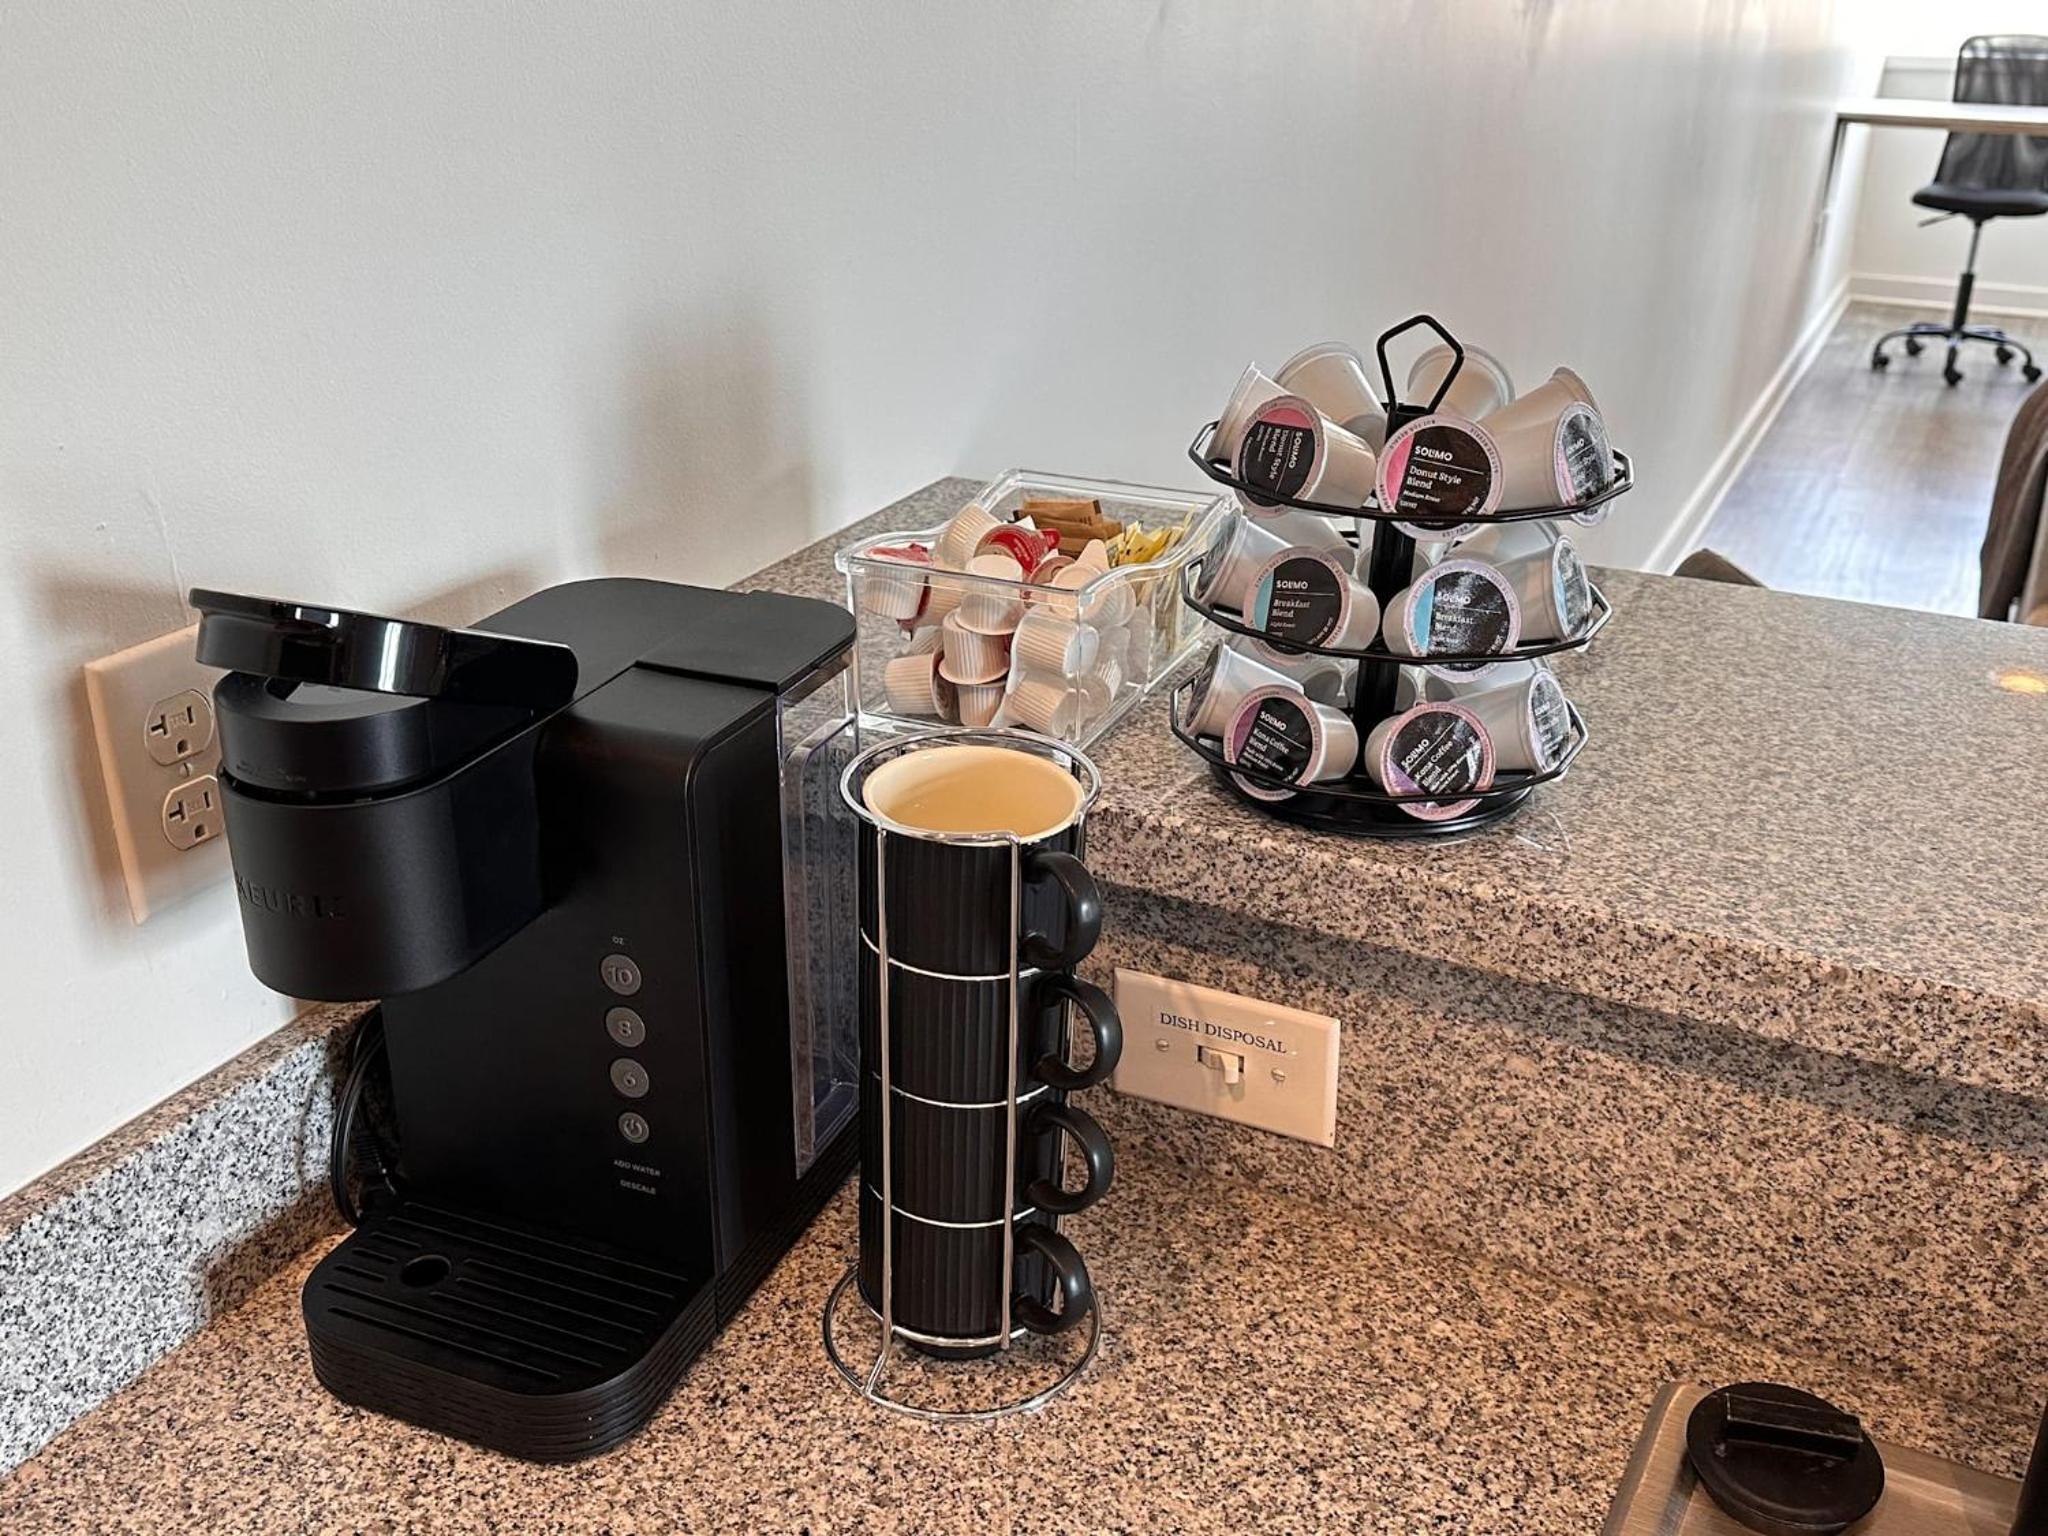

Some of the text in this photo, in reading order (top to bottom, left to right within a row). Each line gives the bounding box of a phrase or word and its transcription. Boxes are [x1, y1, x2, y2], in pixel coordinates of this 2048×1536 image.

[1288, 430, 1304, 470] SOLIMO
[1414, 445, 1454, 463] SOLIMO
[1406, 476, 1433, 490] Blend
[1409, 465, 1463, 485] Donut Style
[1276, 580, 1309, 590] SOLIMO
[1271, 609, 1295, 618] Blend
[1273, 599, 1311, 609] Breakfast
[1260, 710, 1287, 731] SOLIMO
[1401, 738, 1430, 769] SOLIMO
[1414, 761, 1433, 782] Kona
[1430, 740, 1453, 763] Coffee
[608, 966, 633, 986] 10
[619, 1020, 632, 1037] 8
[1160, 1012, 1287, 1053] DISH DISPOSAL
[623, 1071, 637, 1088] 6
